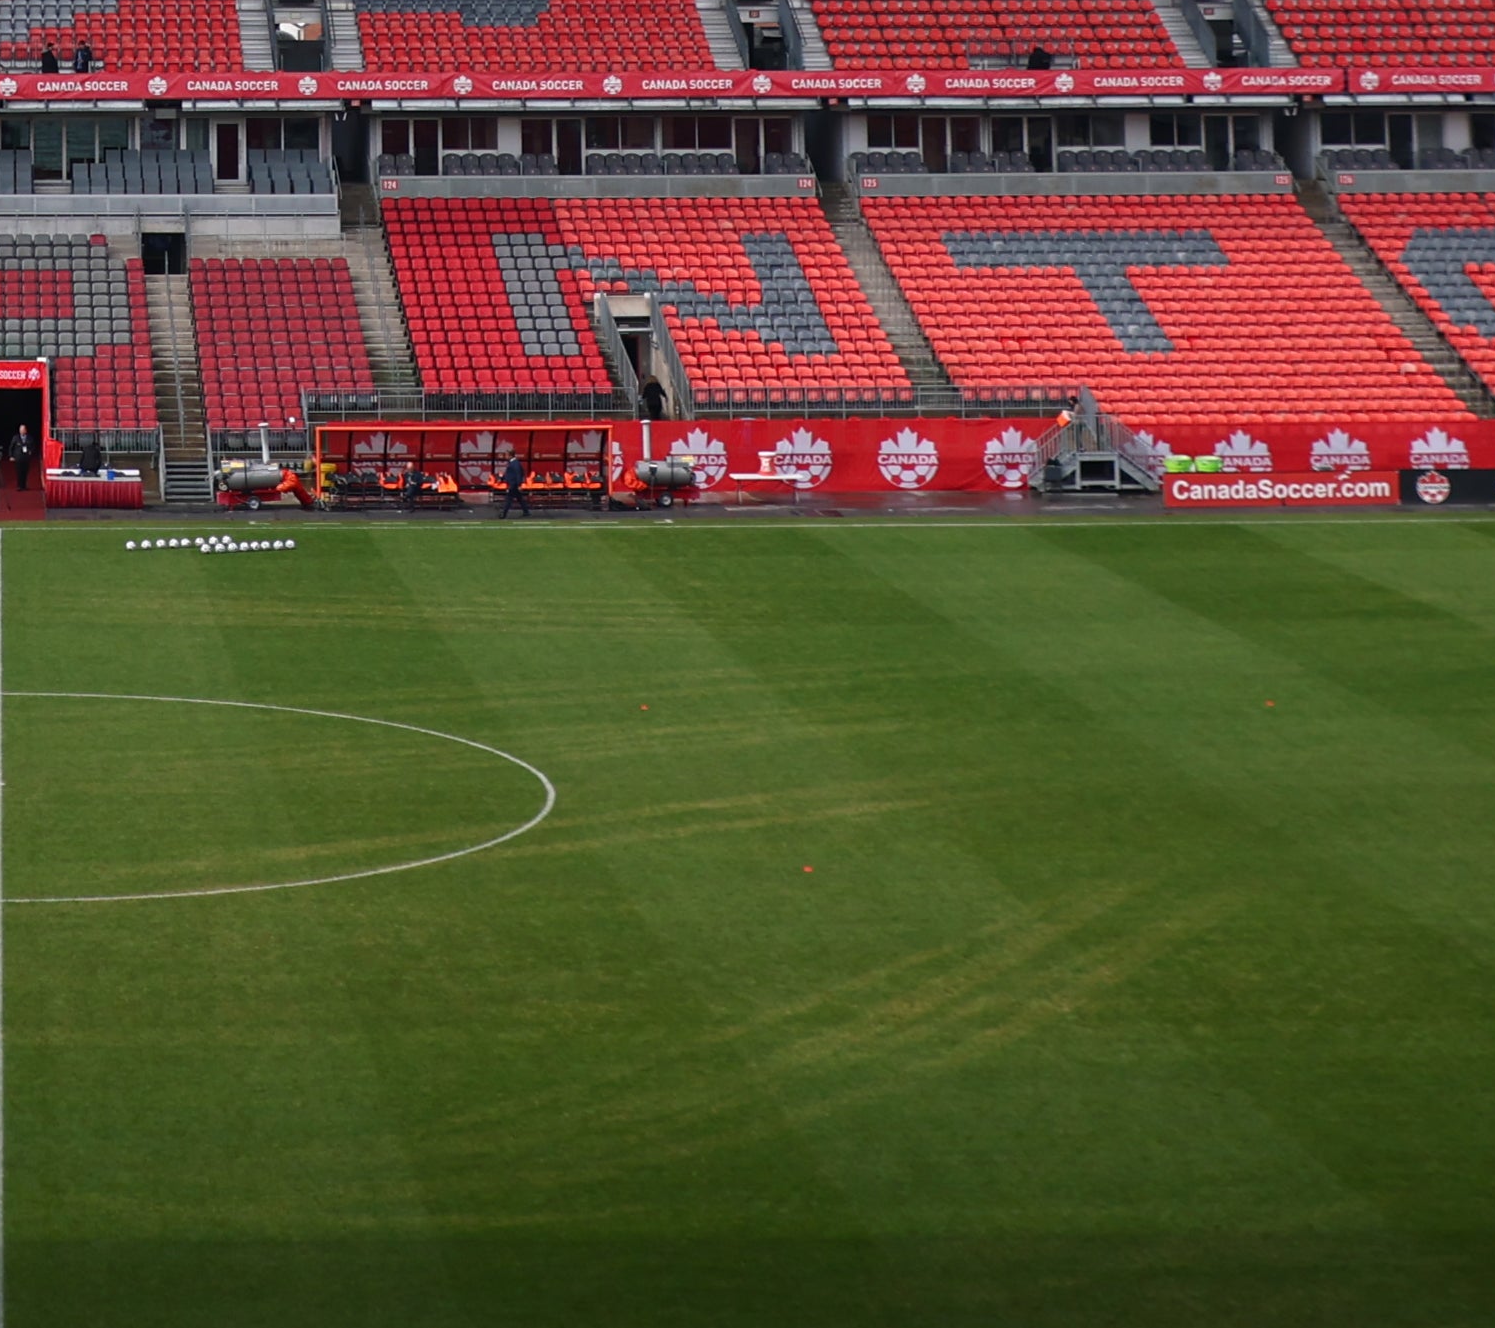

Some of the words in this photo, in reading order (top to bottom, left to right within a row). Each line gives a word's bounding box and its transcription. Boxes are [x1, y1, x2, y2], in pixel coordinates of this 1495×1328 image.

[641, 79, 686, 90] CANADA
[690, 79, 732, 90] SOCCER
[791, 78, 836, 89] CANADA
[839, 78, 881, 89] SOCCER
[945, 77, 990, 89] CANADA
[993, 77, 1035, 89] SOCCER
[1093, 75, 1138, 87] CANADA
[1141, 75, 1183, 87] SOCCER
[1241, 75, 1286, 86] CANADA
[1290, 75, 1332, 86] SOCCER
[1391, 74, 1436, 85] CANADA
[1439, 74, 1481, 85] SOCCER
[36, 80, 81, 92] CANADA
[86, 80, 128, 92] SOCCER
[186, 80, 231, 91] CANADA
[236, 80, 278, 91] SOCCER
[337, 80, 382, 91] CANADA
[386, 80, 428, 91] SOCCER
[491, 80, 536, 91] CANADA
[541, 80, 583, 91] SOCCER
[383, 181, 397, 190] 124
[798, 179, 812, 188] 124
[863, 179, 877, 188] 125
[773, 454, 832, 465] CANADA
[877, 454, 938, 465] CANADA
[983, 454, 1033, 464] CANAD
[1224, 455, 1271, 466] ANADA
[1310, 454, 1370, 465] CANADA
[1409, 453, 1470, 464] CANADA
[1172, 478, 1391, 500] CanadaSoccer.com
